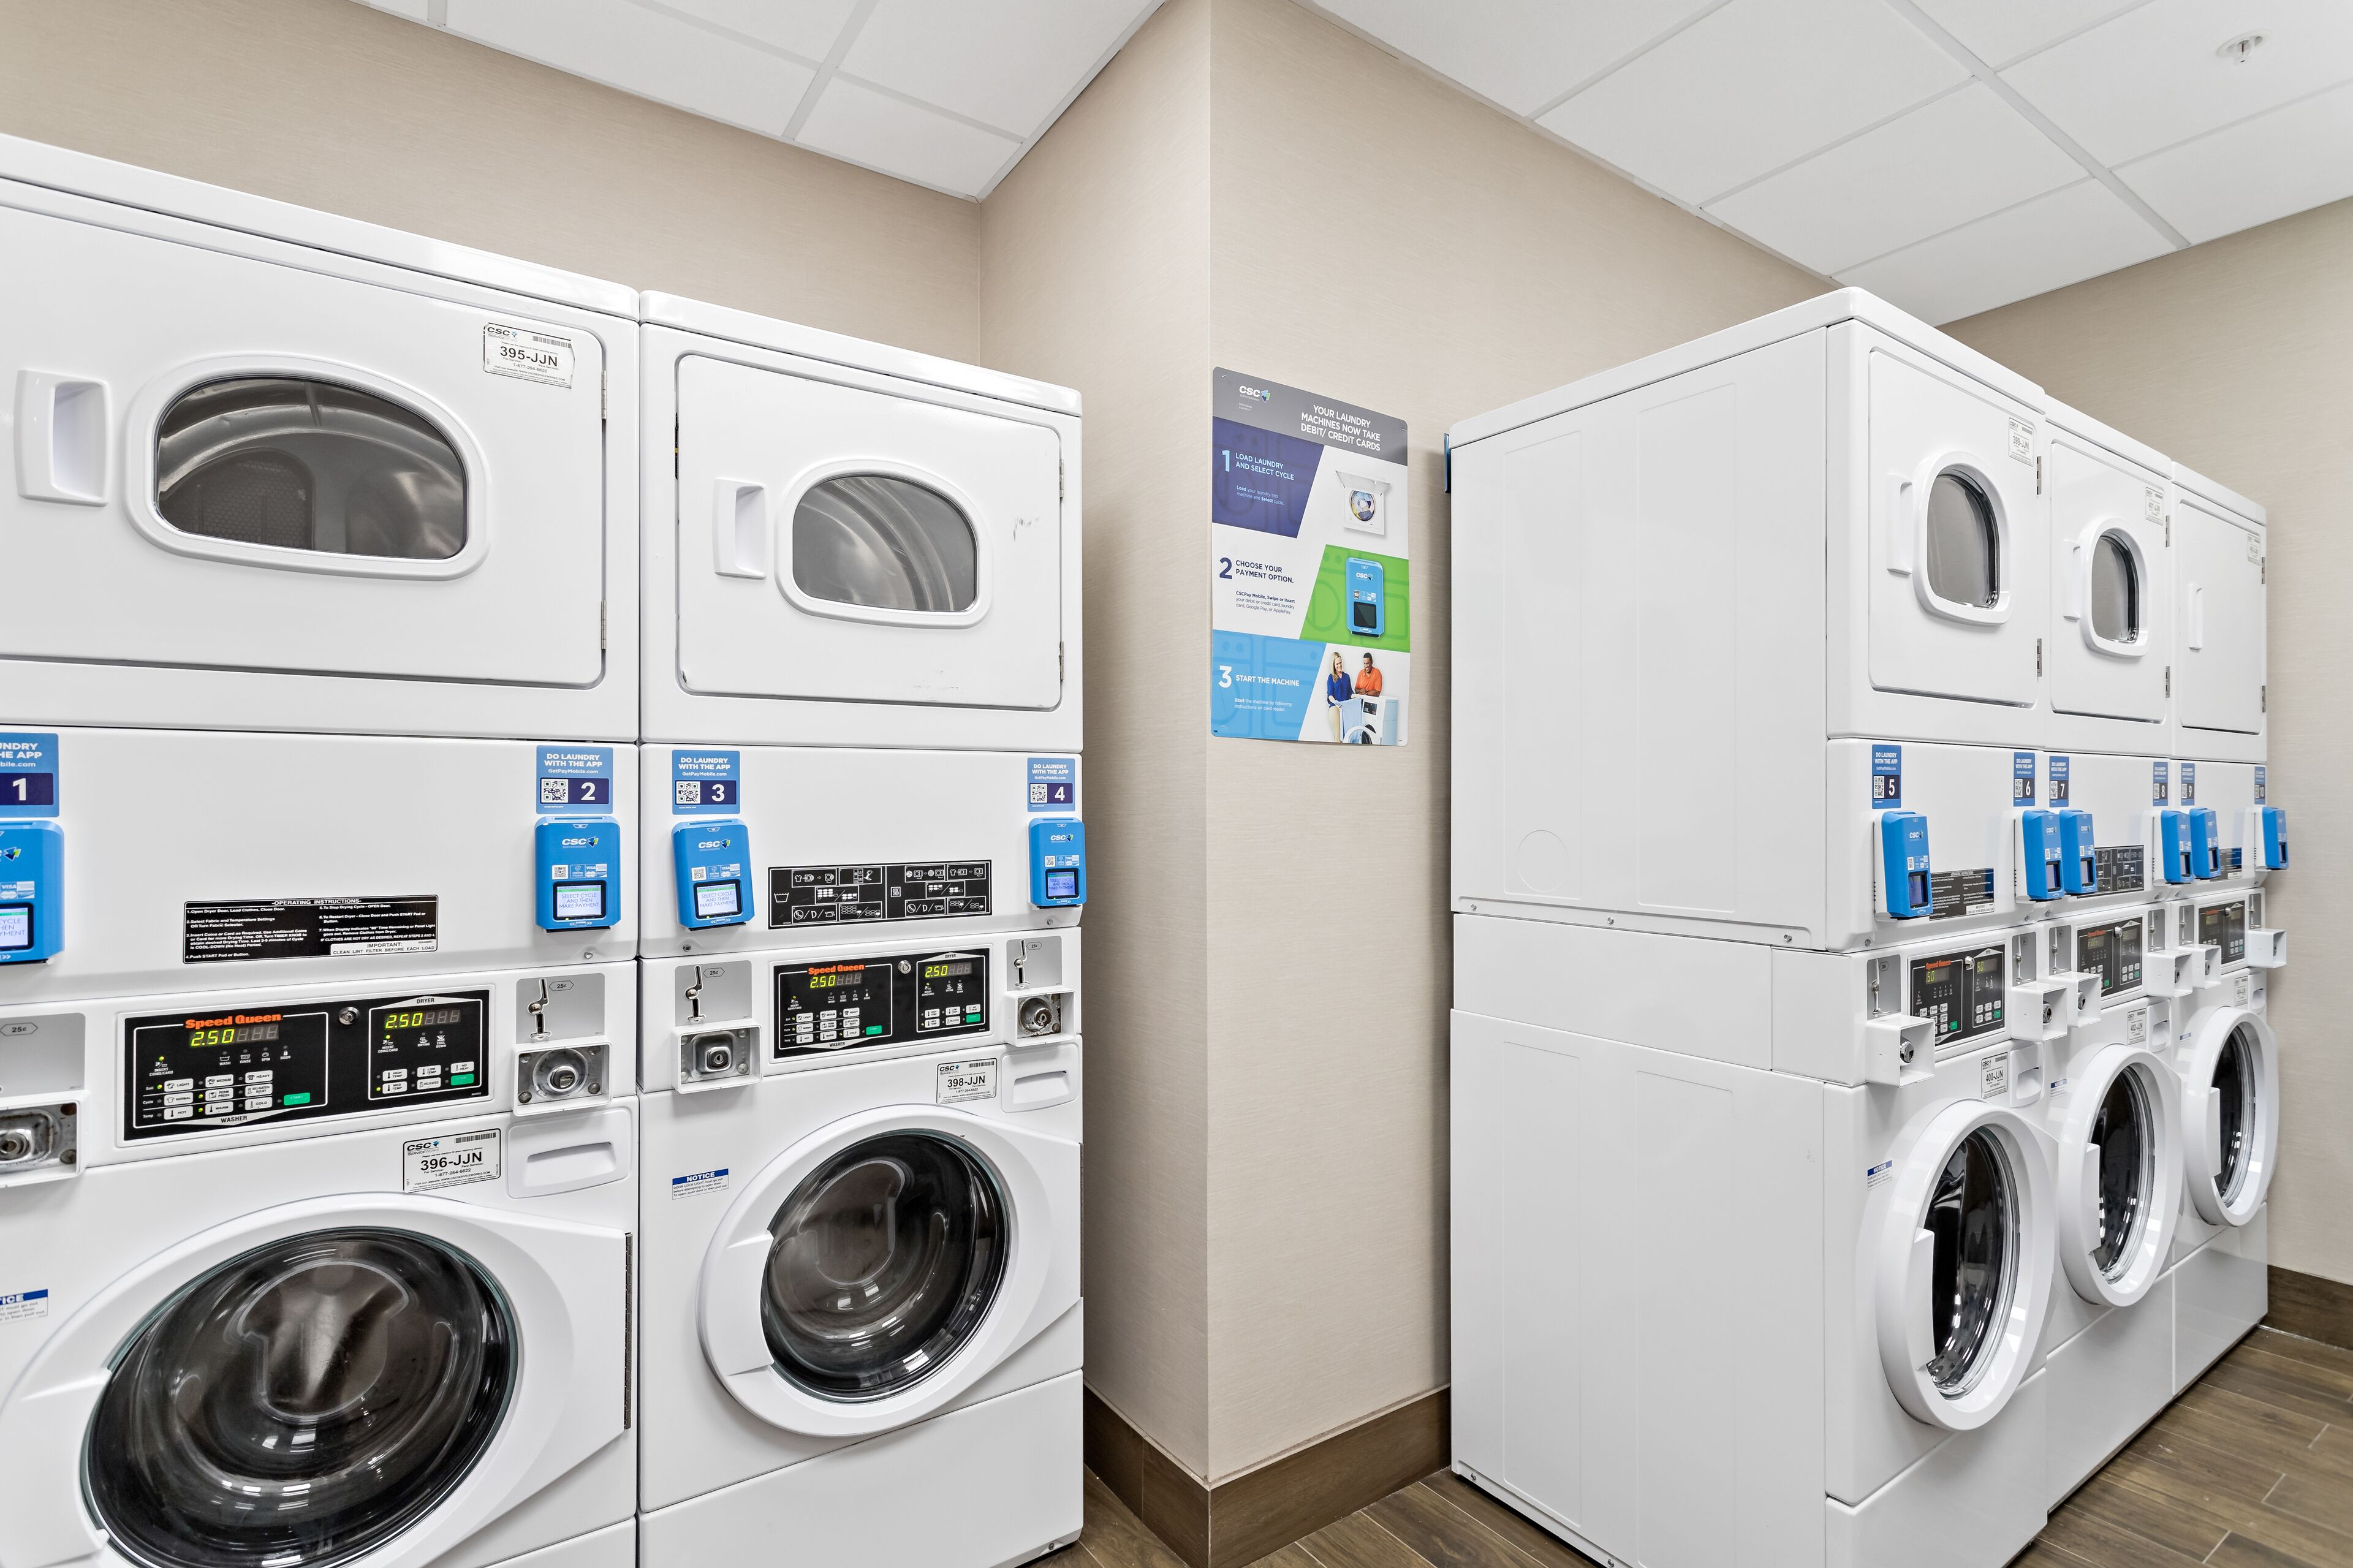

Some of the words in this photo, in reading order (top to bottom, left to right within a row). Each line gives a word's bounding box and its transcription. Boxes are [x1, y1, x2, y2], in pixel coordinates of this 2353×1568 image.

[487, 327, 510, 336] CSC
[499, 346, 558, 367] 395-JJN
[1239, 385, 1260, 398] CSC
[1313, 404, 1335, 418] YOUR
[1336, 411, 1371, 428] LAUNDRY
[1302, 412, 1341, 430] MACHINES
[1342, 423, 1361, 436] NOW
[1362, 429, 1381, 442] TAKE
[1301, 423, 1327, 438] DEBIT/
[1328, 430, 1355, 444] CREDIT
[1356, 438, 1381, 452] CARDS
[1222, 450, 1230, 472] 1
[1235, 452, 1253, 462] LOAD
[1254, 457, 1284, 469] LAUNDRY
[1235, 461, 1249, 470] AND
[1251, 464, 1274, 475] SELECT
[1275, 471, 1294, 480] CYCLE
[1219, 557, 1232, 580] 2
[1235, 560, 1263, 570] CHOOSE
[1265, 564, 1282, 573] YOUR
[1235, 569, 1267, 579] PAYMENT
[1268, 574, 1294, 583] OPTION.
[1218, 665, 1232, 688] 3
[1271, 678, 1300, 686] MACHINE
[12, 778, 26, 801] 1
[580, 782, 596, 801] 2
[711, 784, 725, 801] 3
[1055, 786, 1065, 801] 4
[1889, 779, 1895, 796] 5
[2025, 781, 2031, 796] 6
[2060, 783, 2065, 797] 7
[2161, 785, 2165, 797] 8
[2188, 785, 2192, 797] 9
[808, 966, 836, 975] Speed
[925, 965, 948, 978] 2.50
[1925, 961, 1938, 971] Speed
[810, 975, 836, 988] 2.50
[186, 1016, 233, 1029] Speed
[235, 1013, 281, 1025] Queen
[385, 1012, 423, 1029] 2.50
[191, 1028, 235, 1047] 2.50
[947, 1075, 985, 1088] 398-JJN
[407, 1142, 431, 1151] CSC
[420, 1151, 482, 1171] 396-JJN
[686, 1172, 715, 1182] NOTICE
